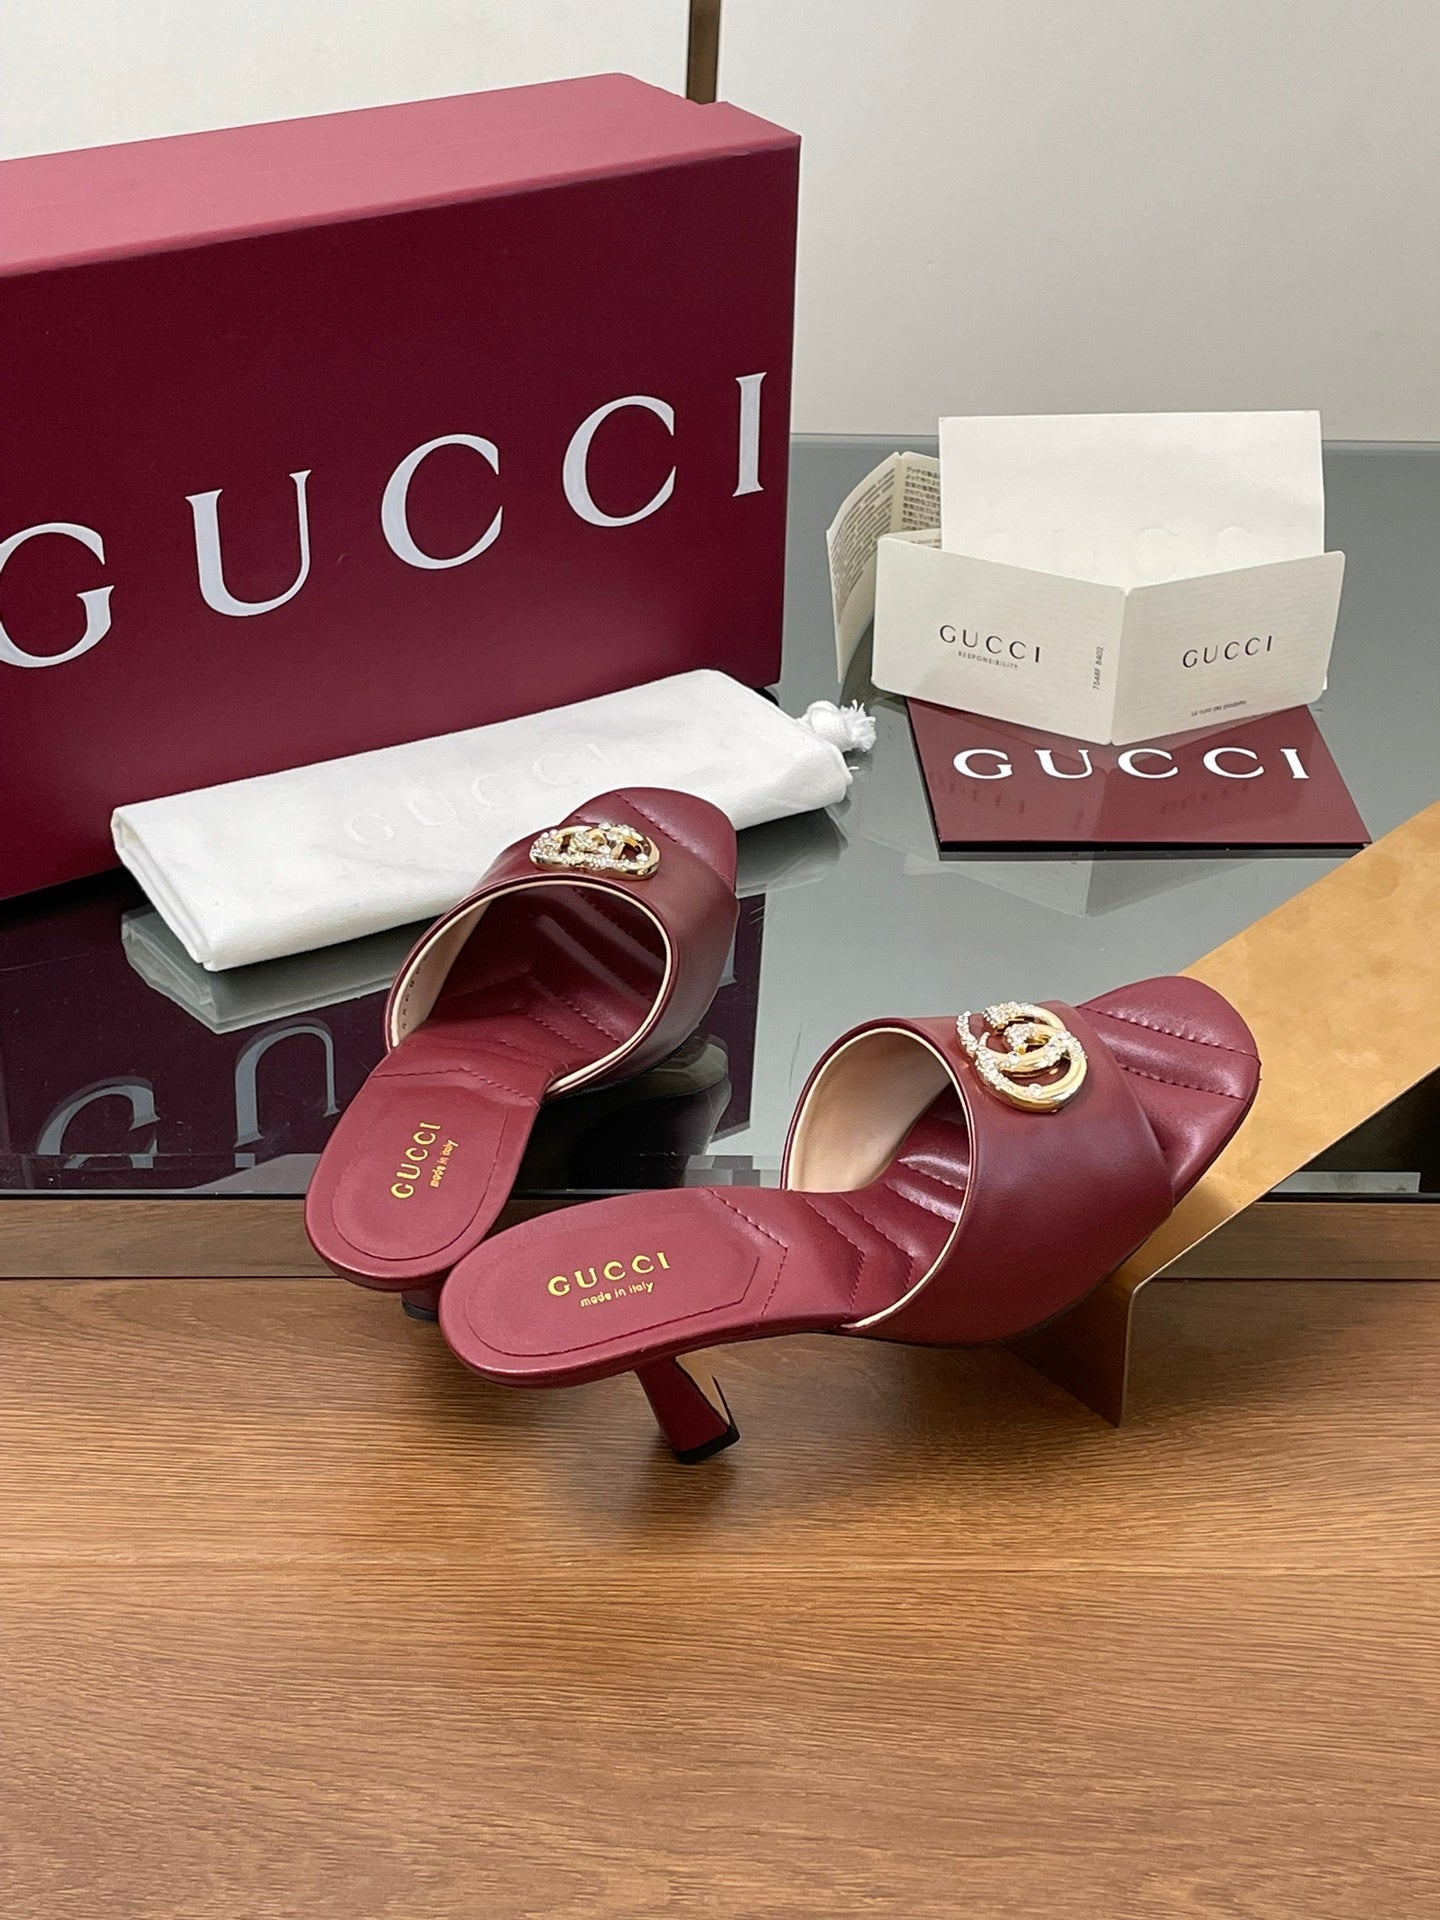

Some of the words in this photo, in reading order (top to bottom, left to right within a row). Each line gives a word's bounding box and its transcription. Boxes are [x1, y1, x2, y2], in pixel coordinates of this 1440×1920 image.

[0, 371, 767, 668] GUCCI
[939, 624, 1041, 663] GUCCI
[958, 650, 1019, 670] RESPONSIBILITY
[1182, 635, 1273, 668] GUCCI
[952, 746, 1310, 780] GUCCI
[390, 1121, 441, 1199] GUCCI
[547, 1251, 671, 1297] GUCCI
[580, 1291, 612, 1308] made
[614, 1287, 627, 1299] in
[629, 1281, 654, 1294] italy
